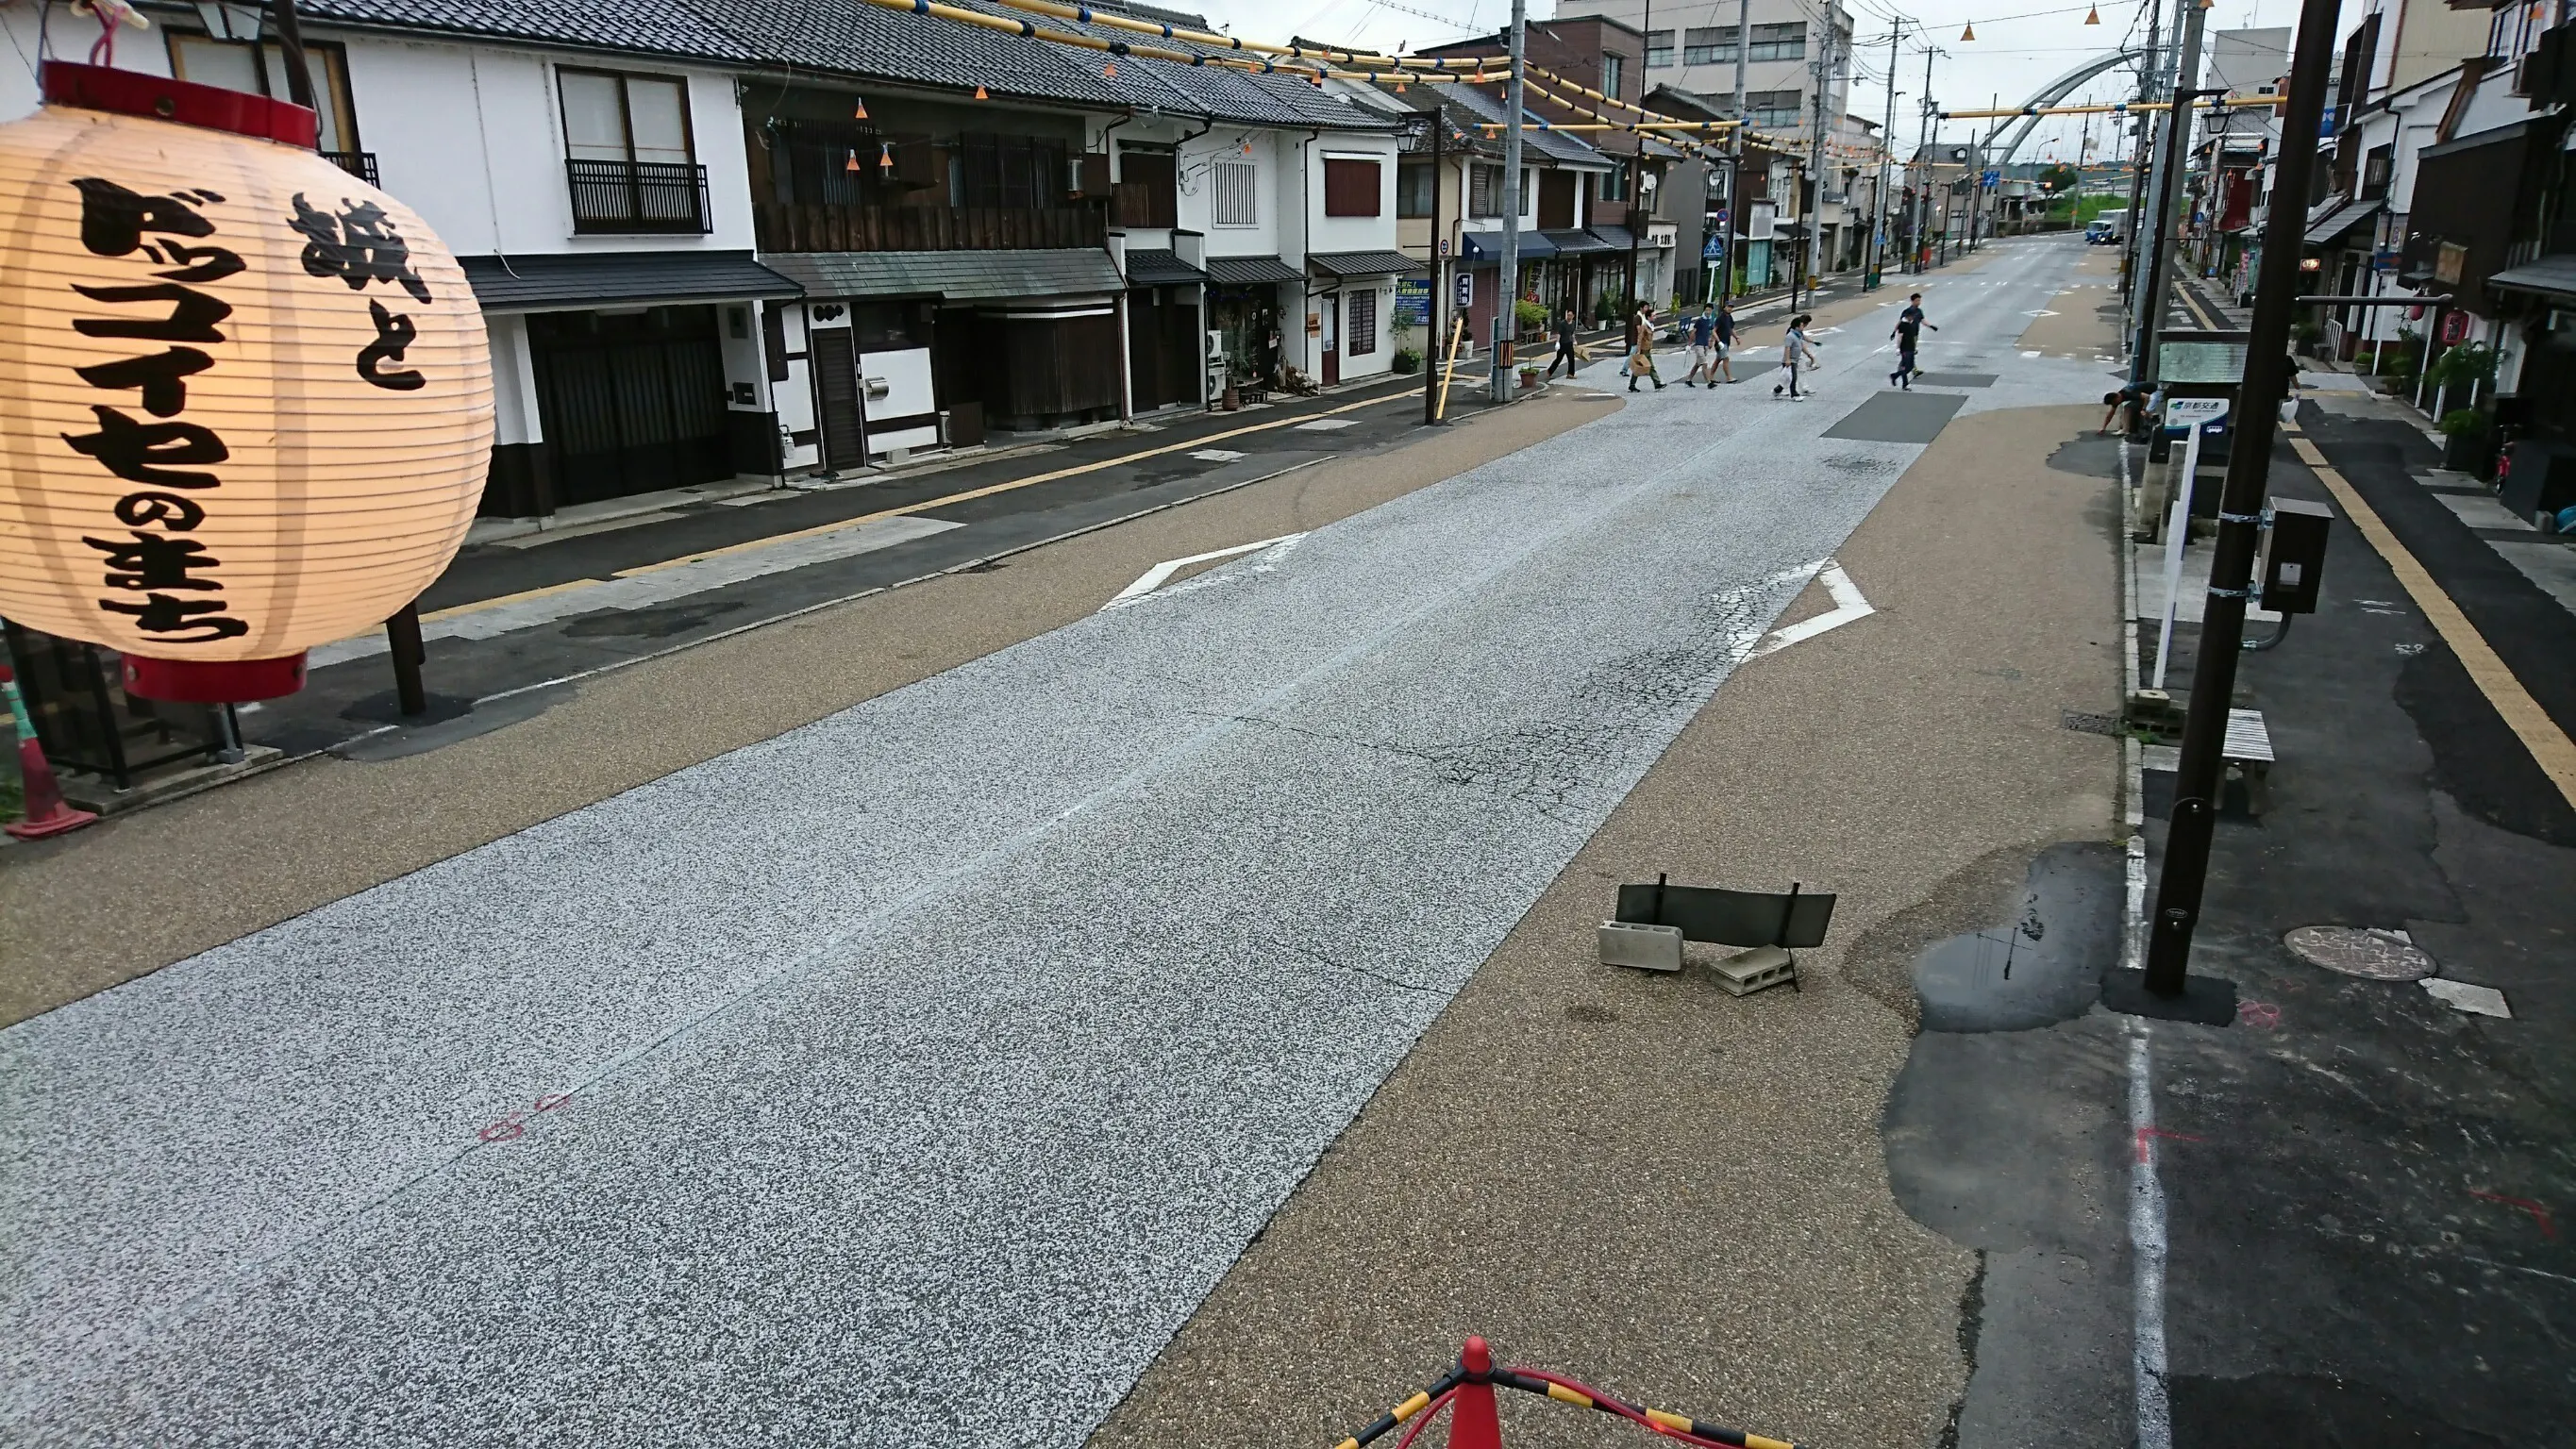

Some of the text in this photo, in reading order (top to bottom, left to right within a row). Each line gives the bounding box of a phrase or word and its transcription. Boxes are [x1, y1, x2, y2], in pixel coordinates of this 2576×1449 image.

[60, 177, 248, 643] ドッコイセのまち
[2183, 401, 2219, 409] 京都交通
